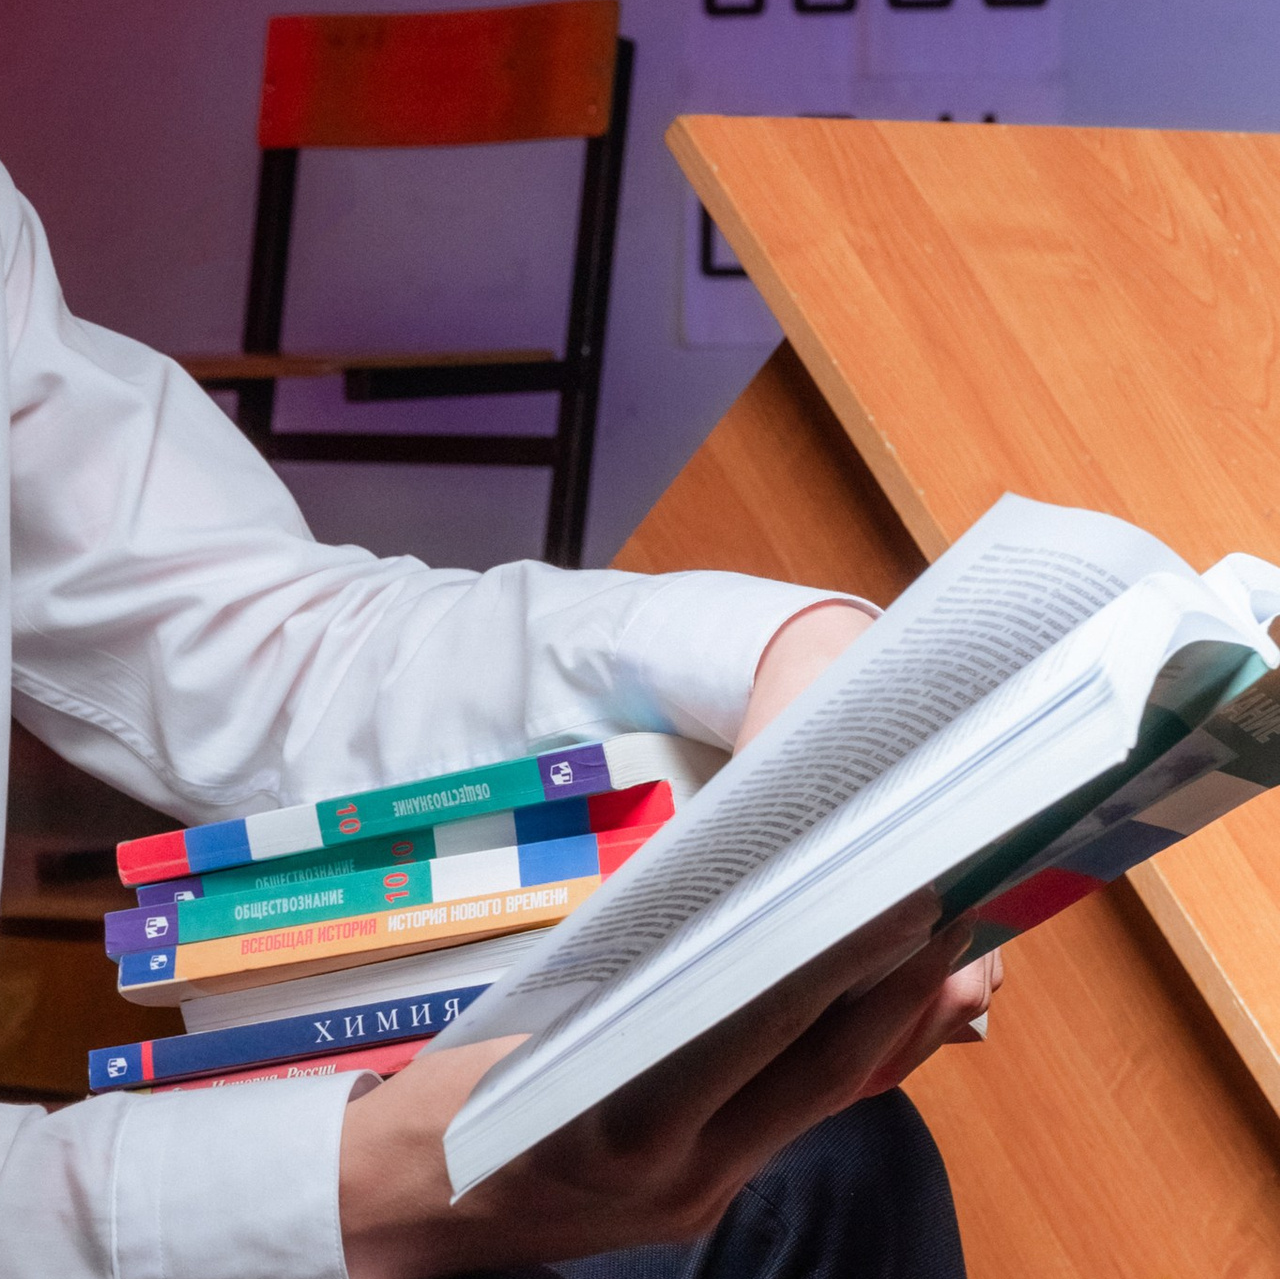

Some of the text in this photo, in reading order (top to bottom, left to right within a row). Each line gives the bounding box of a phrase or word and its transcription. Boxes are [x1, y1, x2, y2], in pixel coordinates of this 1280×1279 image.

[392, 782, 491, 818] ОБЩЕСТВОЗНАНИЕ
[336, 803, 361, 834] 10
[255, 859, 356, 889] ОБЩЕСТВОЗНАНИЕ
[383, 872, 409, 903] 10
[234, 889, 345, 921] ОБЩЕСТВОЗНАНИЕ
[387, 887, 569, 932] ИСТОРИЯ НОВОГО ВРЕМЕНИ
[241, 918, 377, 955] ВСЕОБЩАЯ ИСТОРИЯ
[314, 998, 461, 1043] ХИМИЯ
